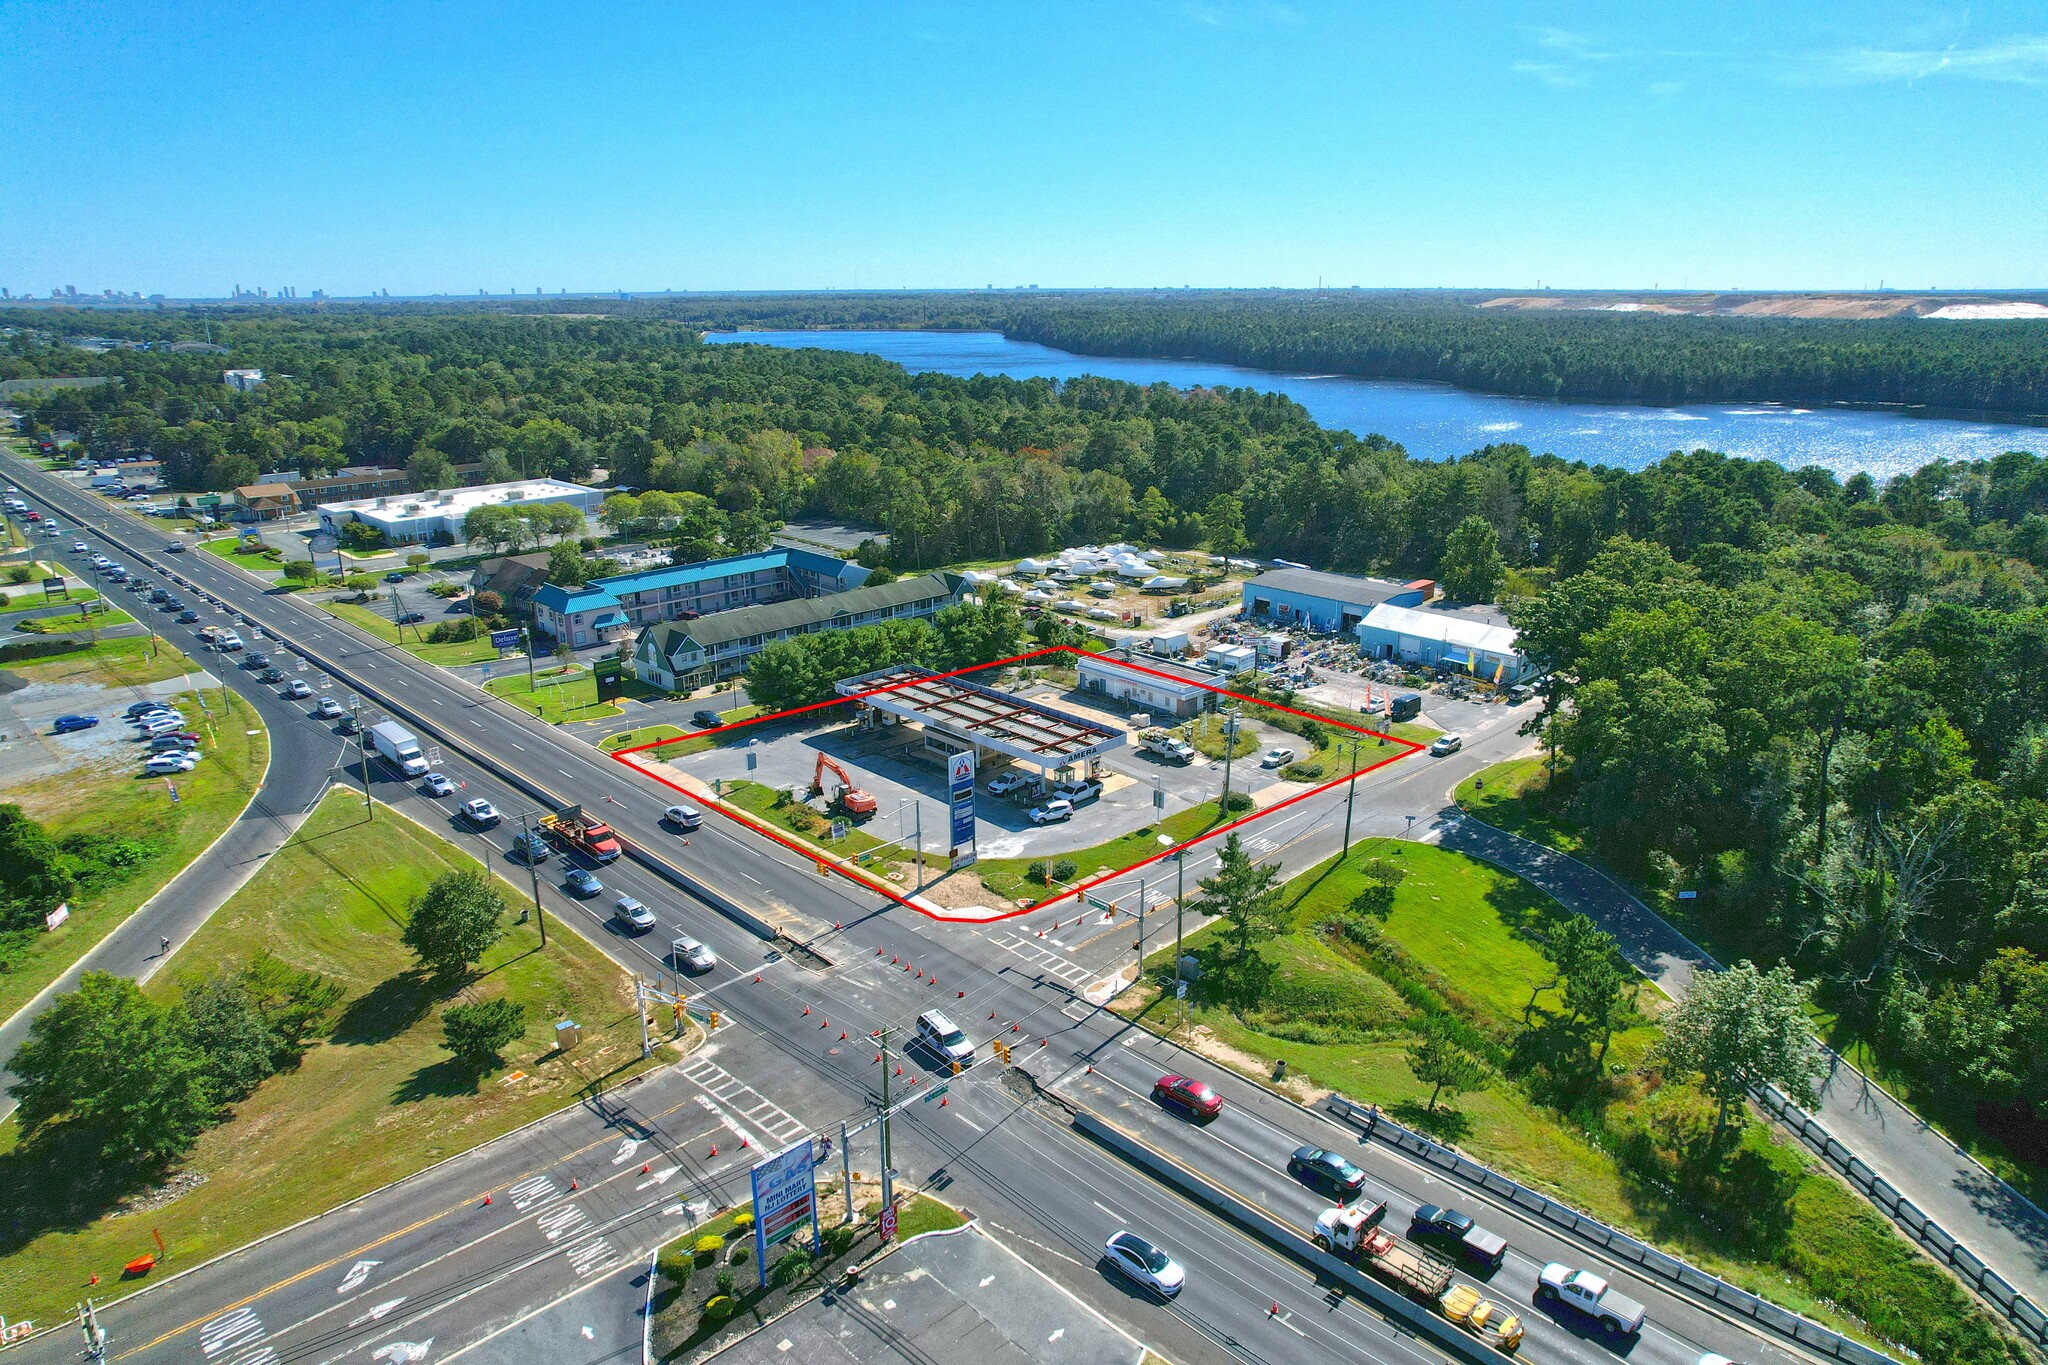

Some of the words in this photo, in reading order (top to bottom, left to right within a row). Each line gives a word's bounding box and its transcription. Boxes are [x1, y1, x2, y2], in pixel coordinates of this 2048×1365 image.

[1068, 747, 1097, 762] AMERA
[769, 1162, 808, 1188] GAS
[764, 1202, 775, 1212] NJ
[777, 1183, 807, 1203] LOTTERY
[766, 1191, 784, 1204] MINI
[785, 1178, 805, 1194] MART
[199, 1307, 266, 1359] ONLY
